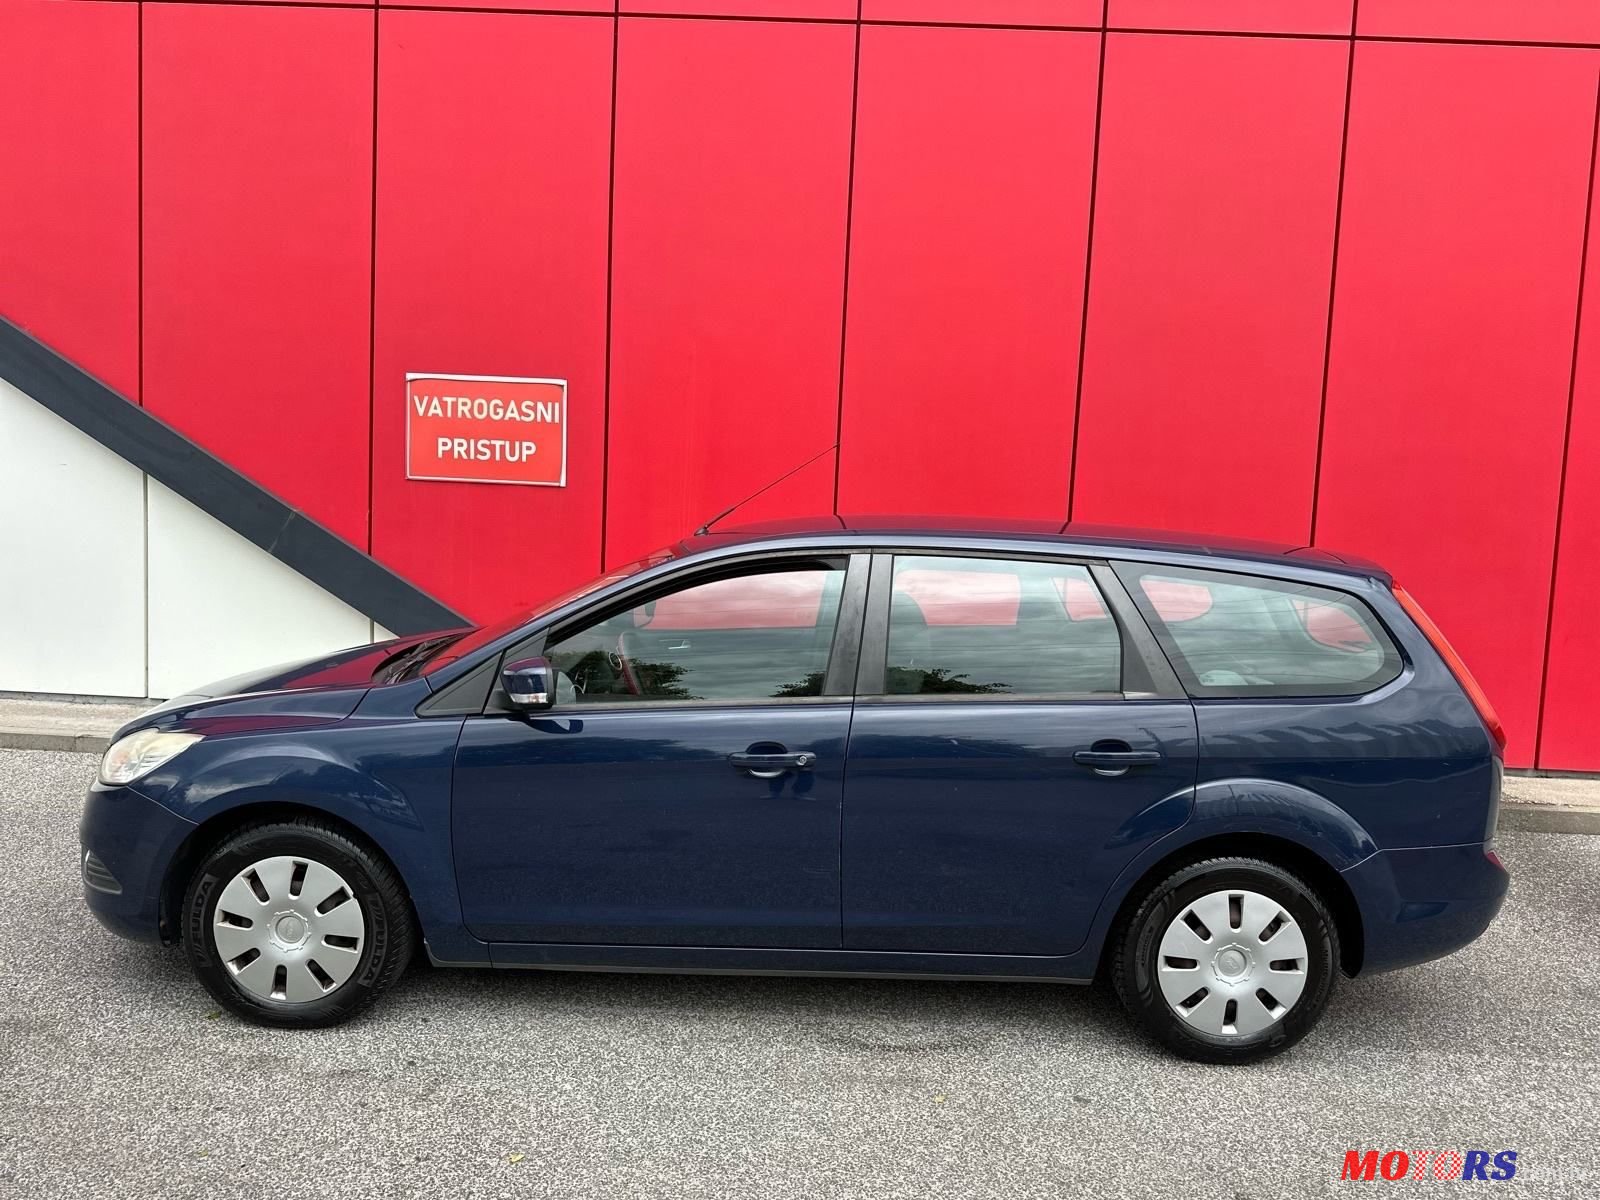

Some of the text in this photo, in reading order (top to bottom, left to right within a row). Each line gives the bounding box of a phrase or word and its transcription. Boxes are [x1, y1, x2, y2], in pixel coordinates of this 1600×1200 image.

[413, 395, 560, 424] VATROGASNI
[437, 437, 537, 462] PRISTUP
[191, 880, 214, 943] FULDA
[363, 920, 387, 981] FULDA
